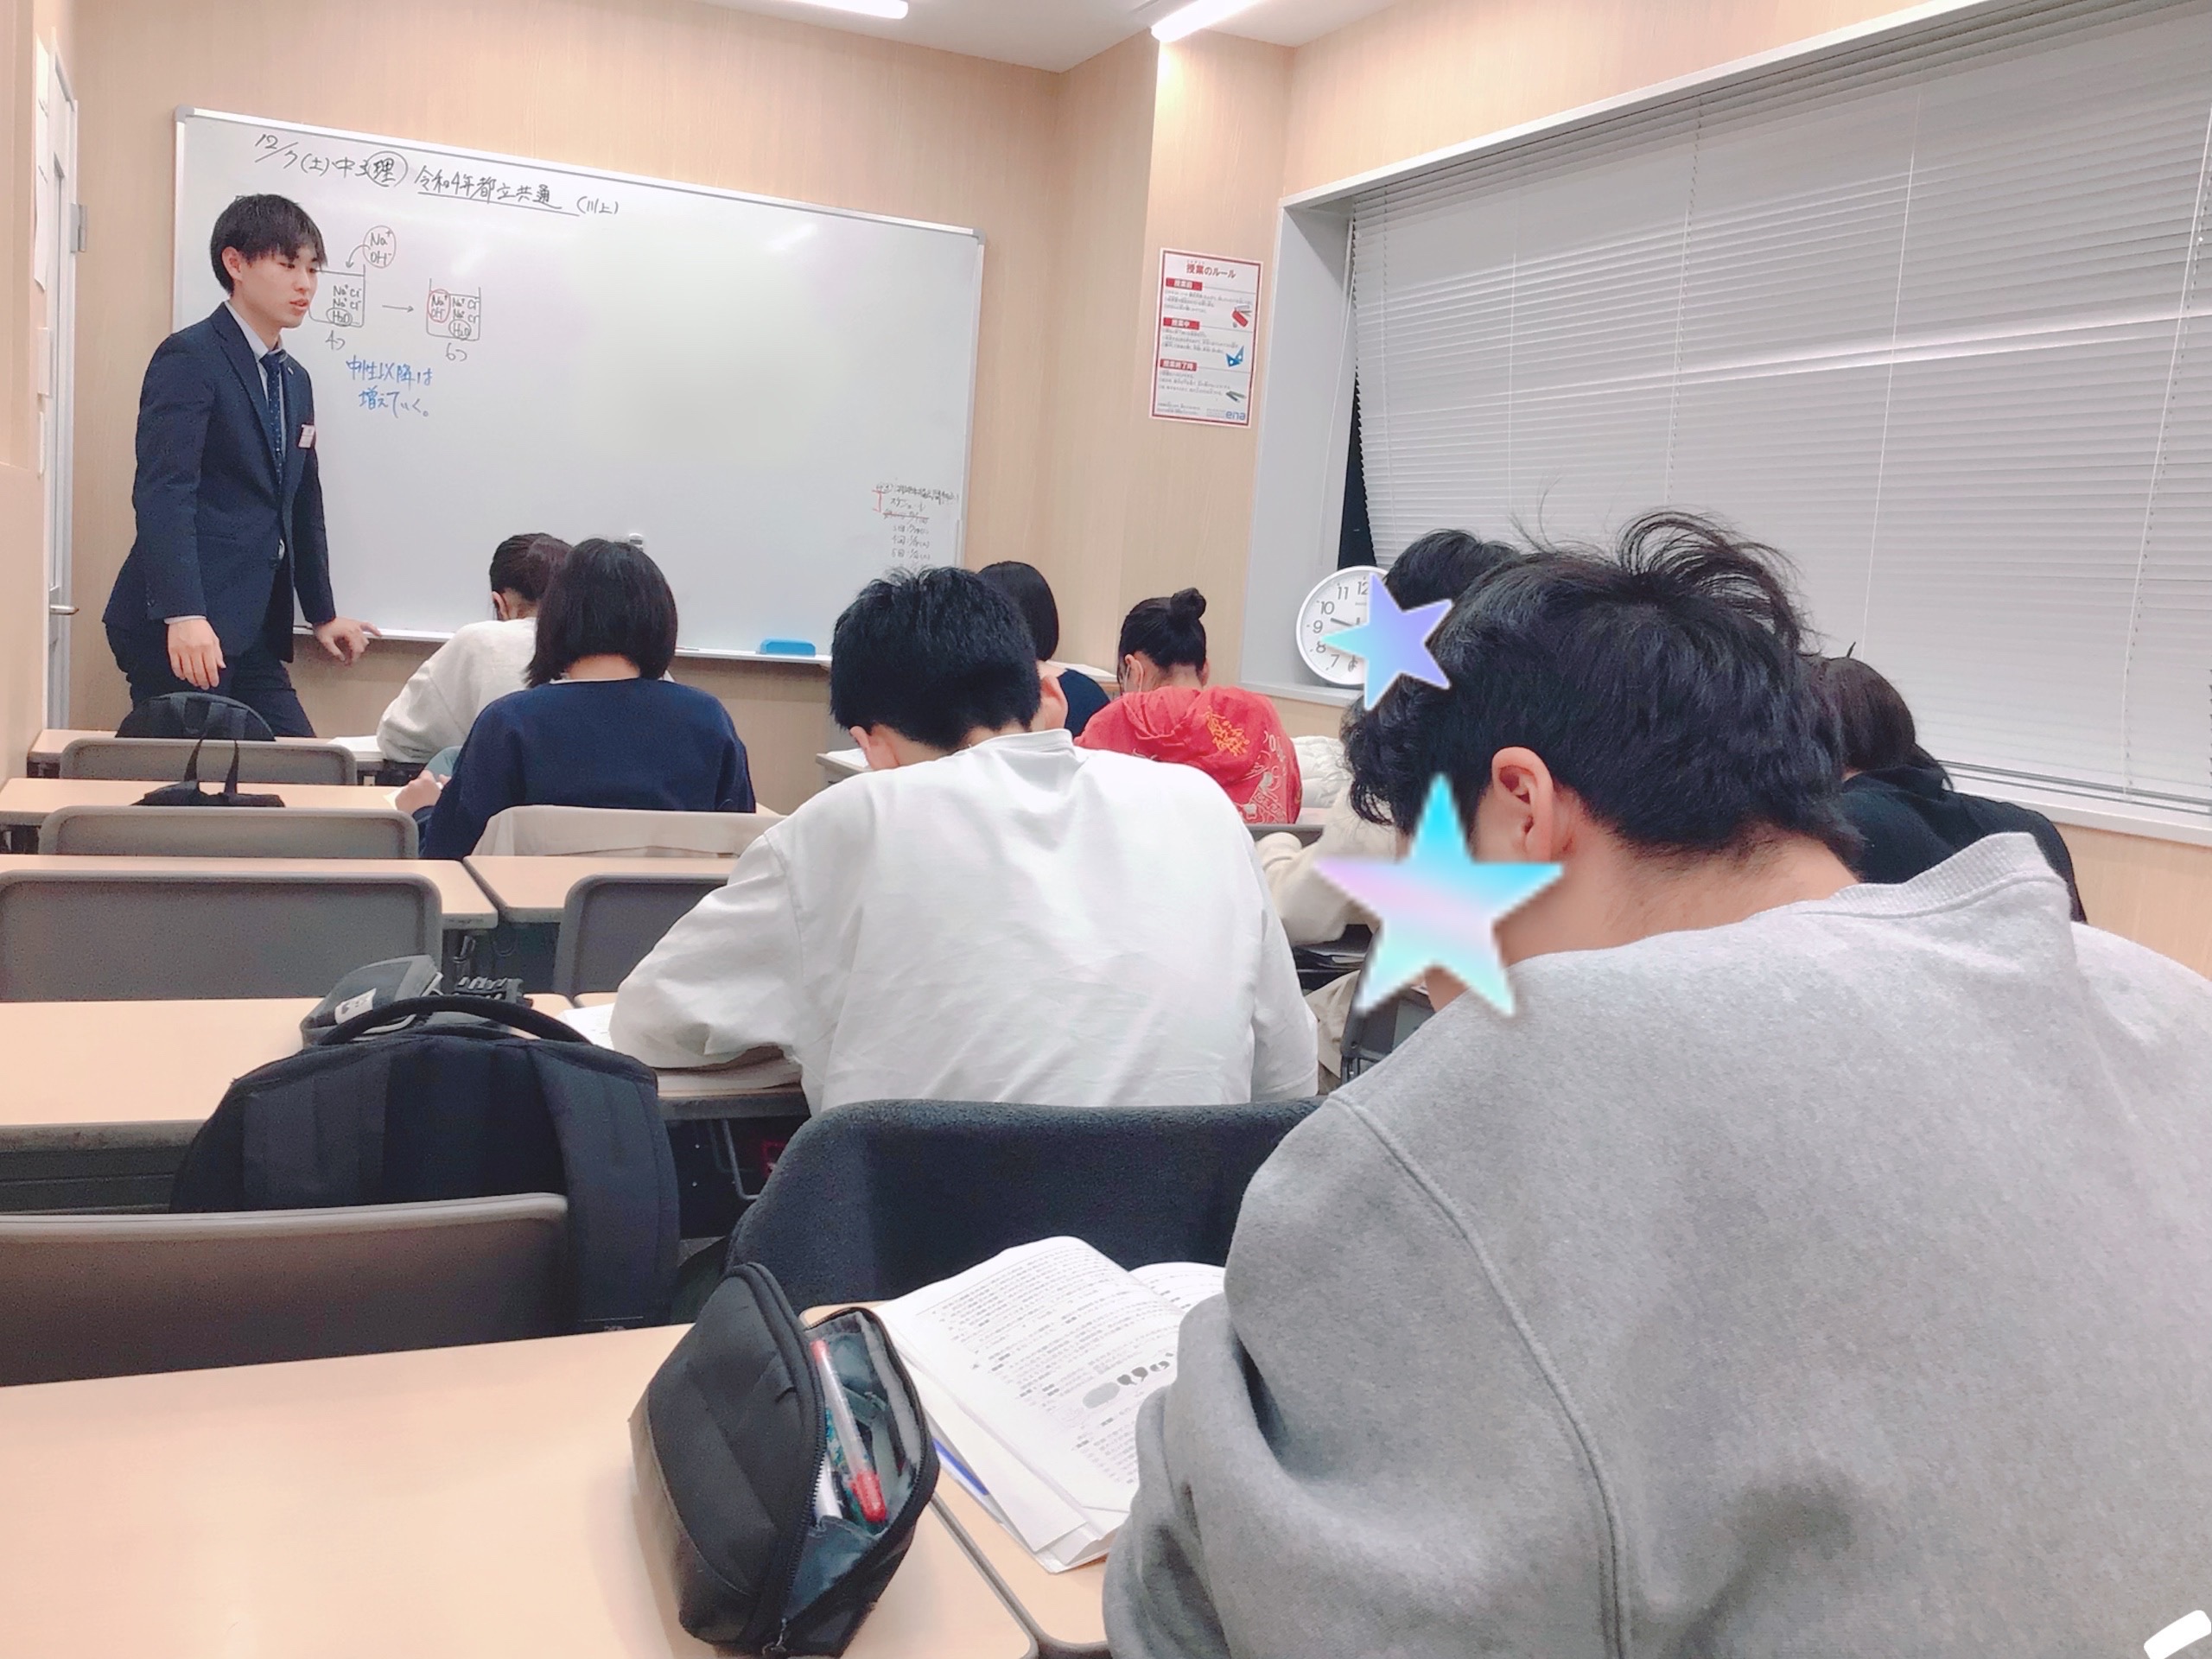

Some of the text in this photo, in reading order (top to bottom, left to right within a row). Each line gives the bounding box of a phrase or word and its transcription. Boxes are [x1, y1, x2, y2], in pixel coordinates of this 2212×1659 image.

[1186, 264, 1236, 278] 授業のルール
[346, 354, 433, 391] 中性以降は
[1225, 410, 1247, 421] ena
[1337, 586, 1350, 601] 11
[1320, 601, 1335, 615] 10
[1313, 620, 1323, 634] 9
[1331, 654, 1340, 668] 7
